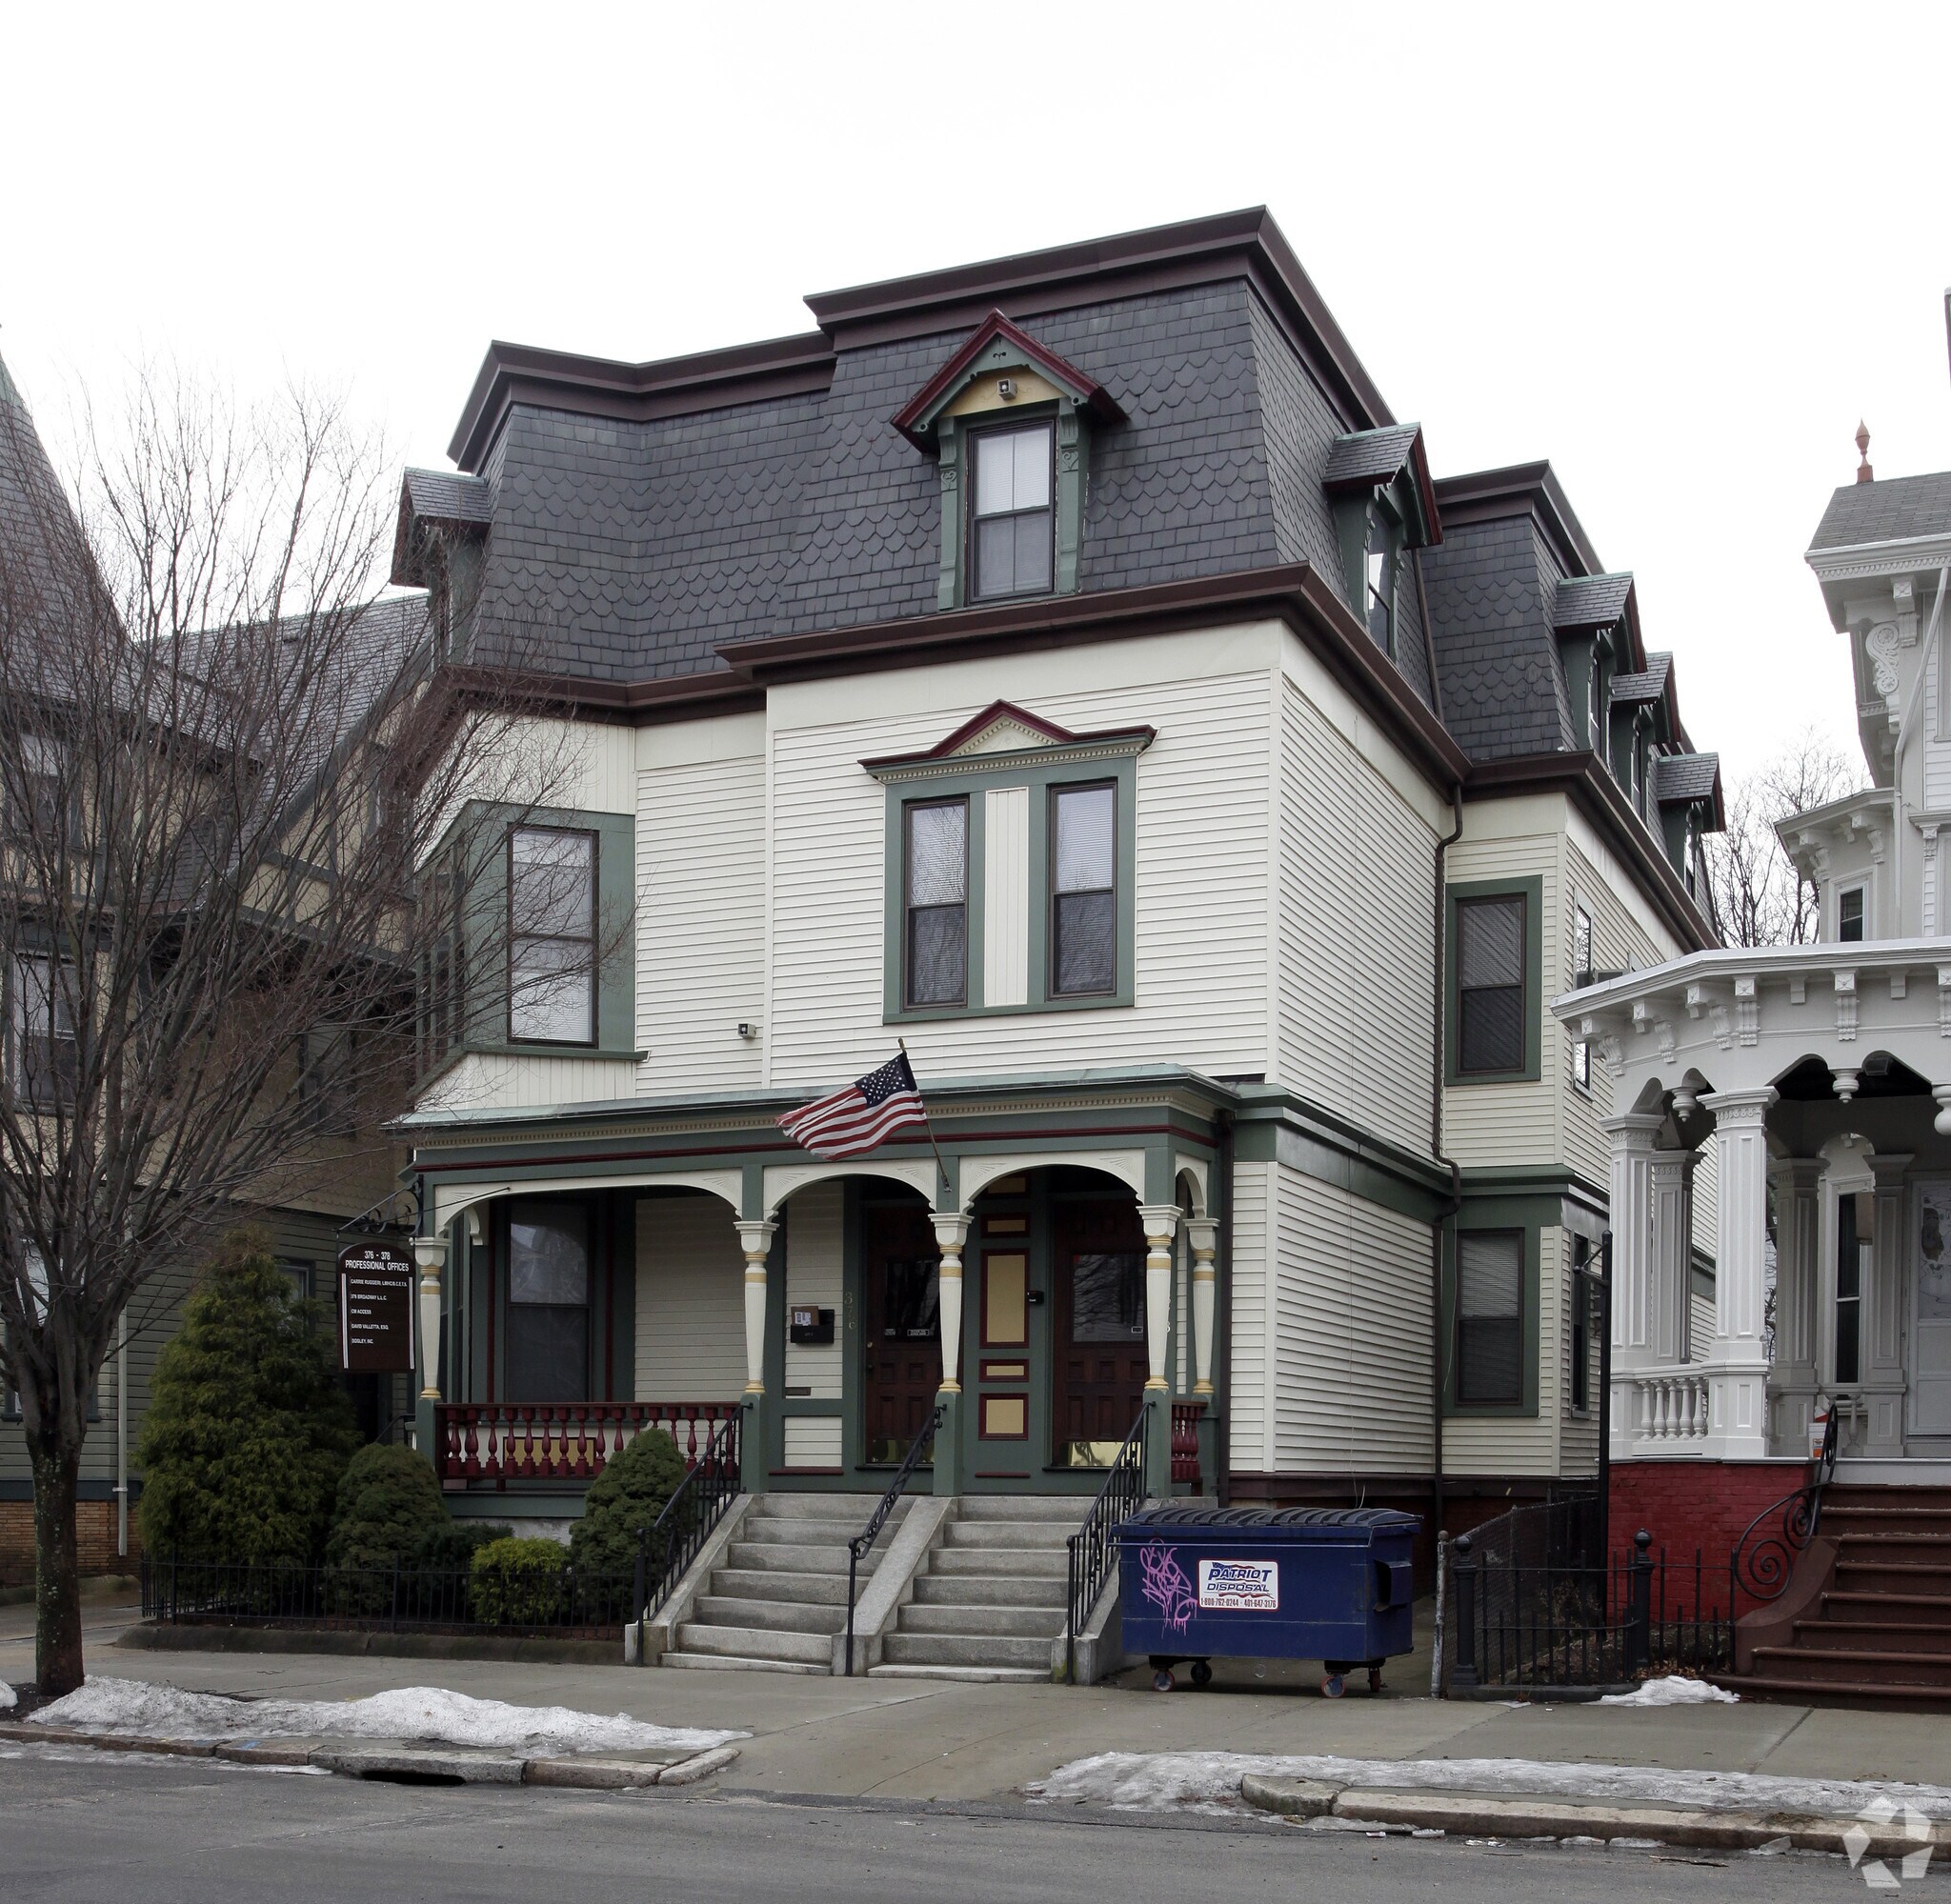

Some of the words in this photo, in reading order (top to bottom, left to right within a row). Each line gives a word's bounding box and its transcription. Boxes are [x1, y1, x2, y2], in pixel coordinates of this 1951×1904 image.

[364, 1251, 374, 1259] 376
[380, 1252, 391, 1260] 378
[345, 1259, 386, 1271] PROFESSIONAL
[387, 1262, 409, 1272] OFFICES
[1208, 1568, 1273, 1582] PATRIOT
[1206, 1583, 1270, 1593] DISPOSAL
